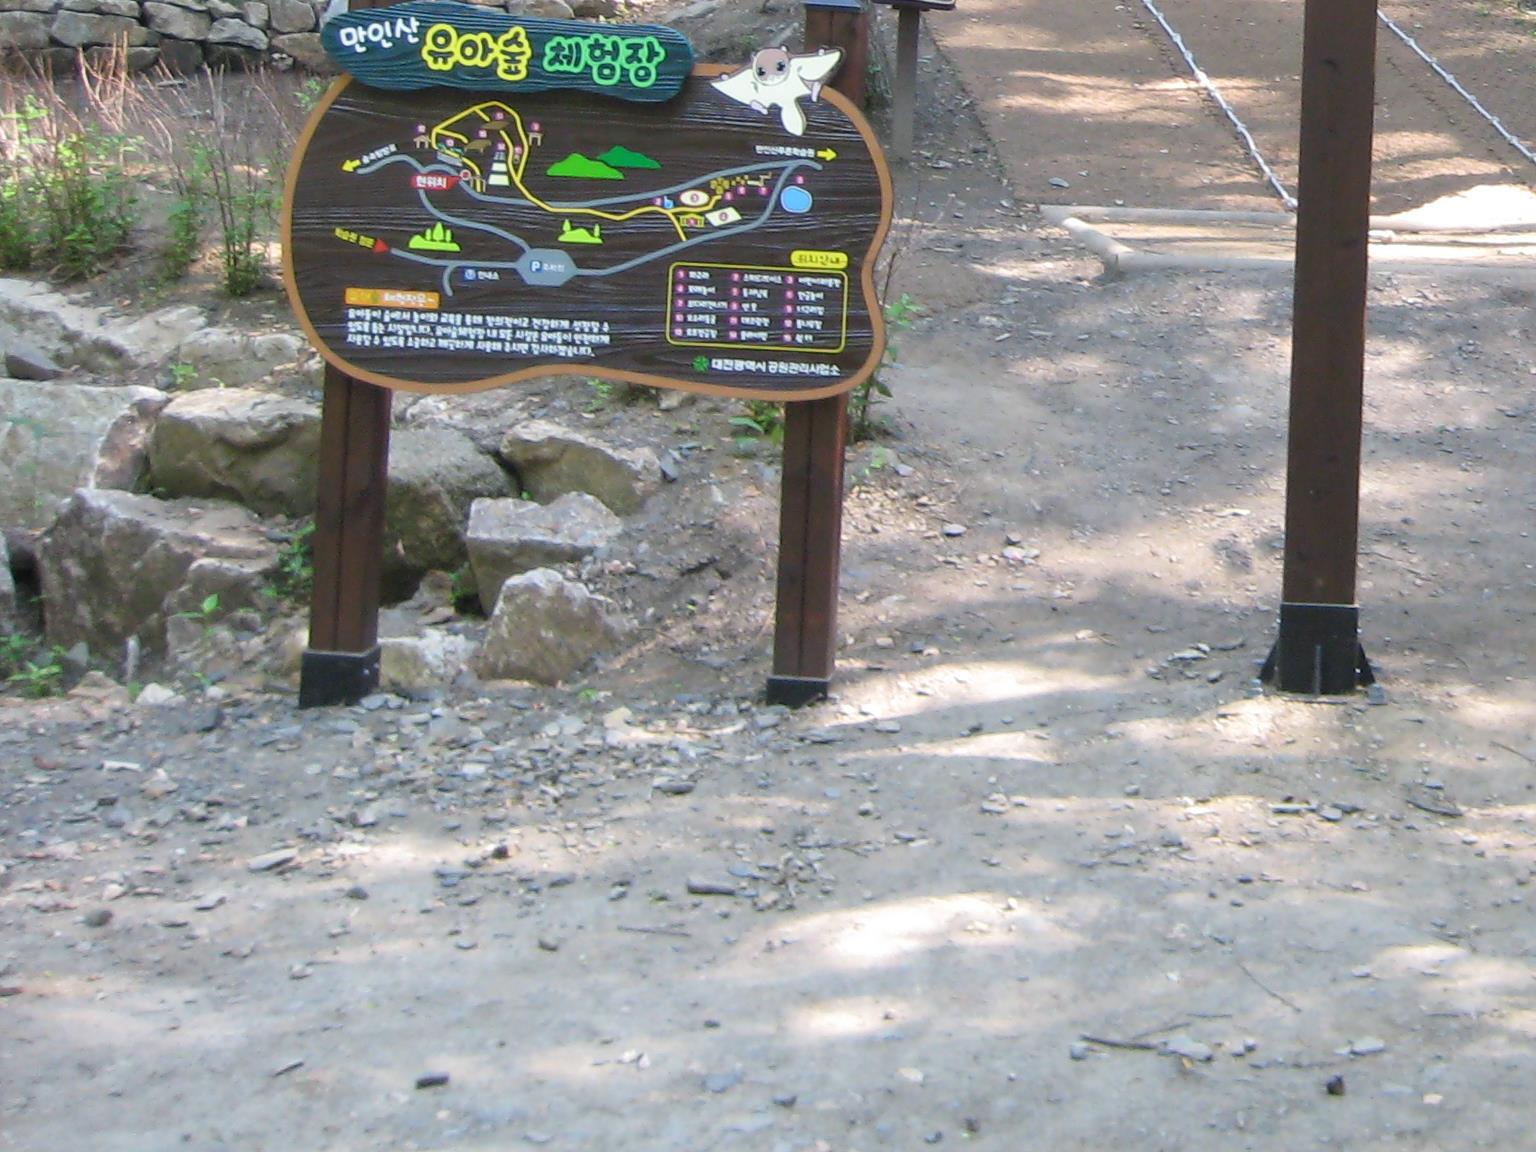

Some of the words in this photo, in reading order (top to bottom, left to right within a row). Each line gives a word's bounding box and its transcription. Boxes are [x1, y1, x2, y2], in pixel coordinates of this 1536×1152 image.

[339, 18, 420, 54] 만인산
[421, 23, 533, 81] 유아숲
[543, 33, 666, 88] 체험장
[416, 176, 447, 189] 현위치
[711, 358, 766, 372] 대전광역시
[768, 360, 841, 376] 공원관리사업소
